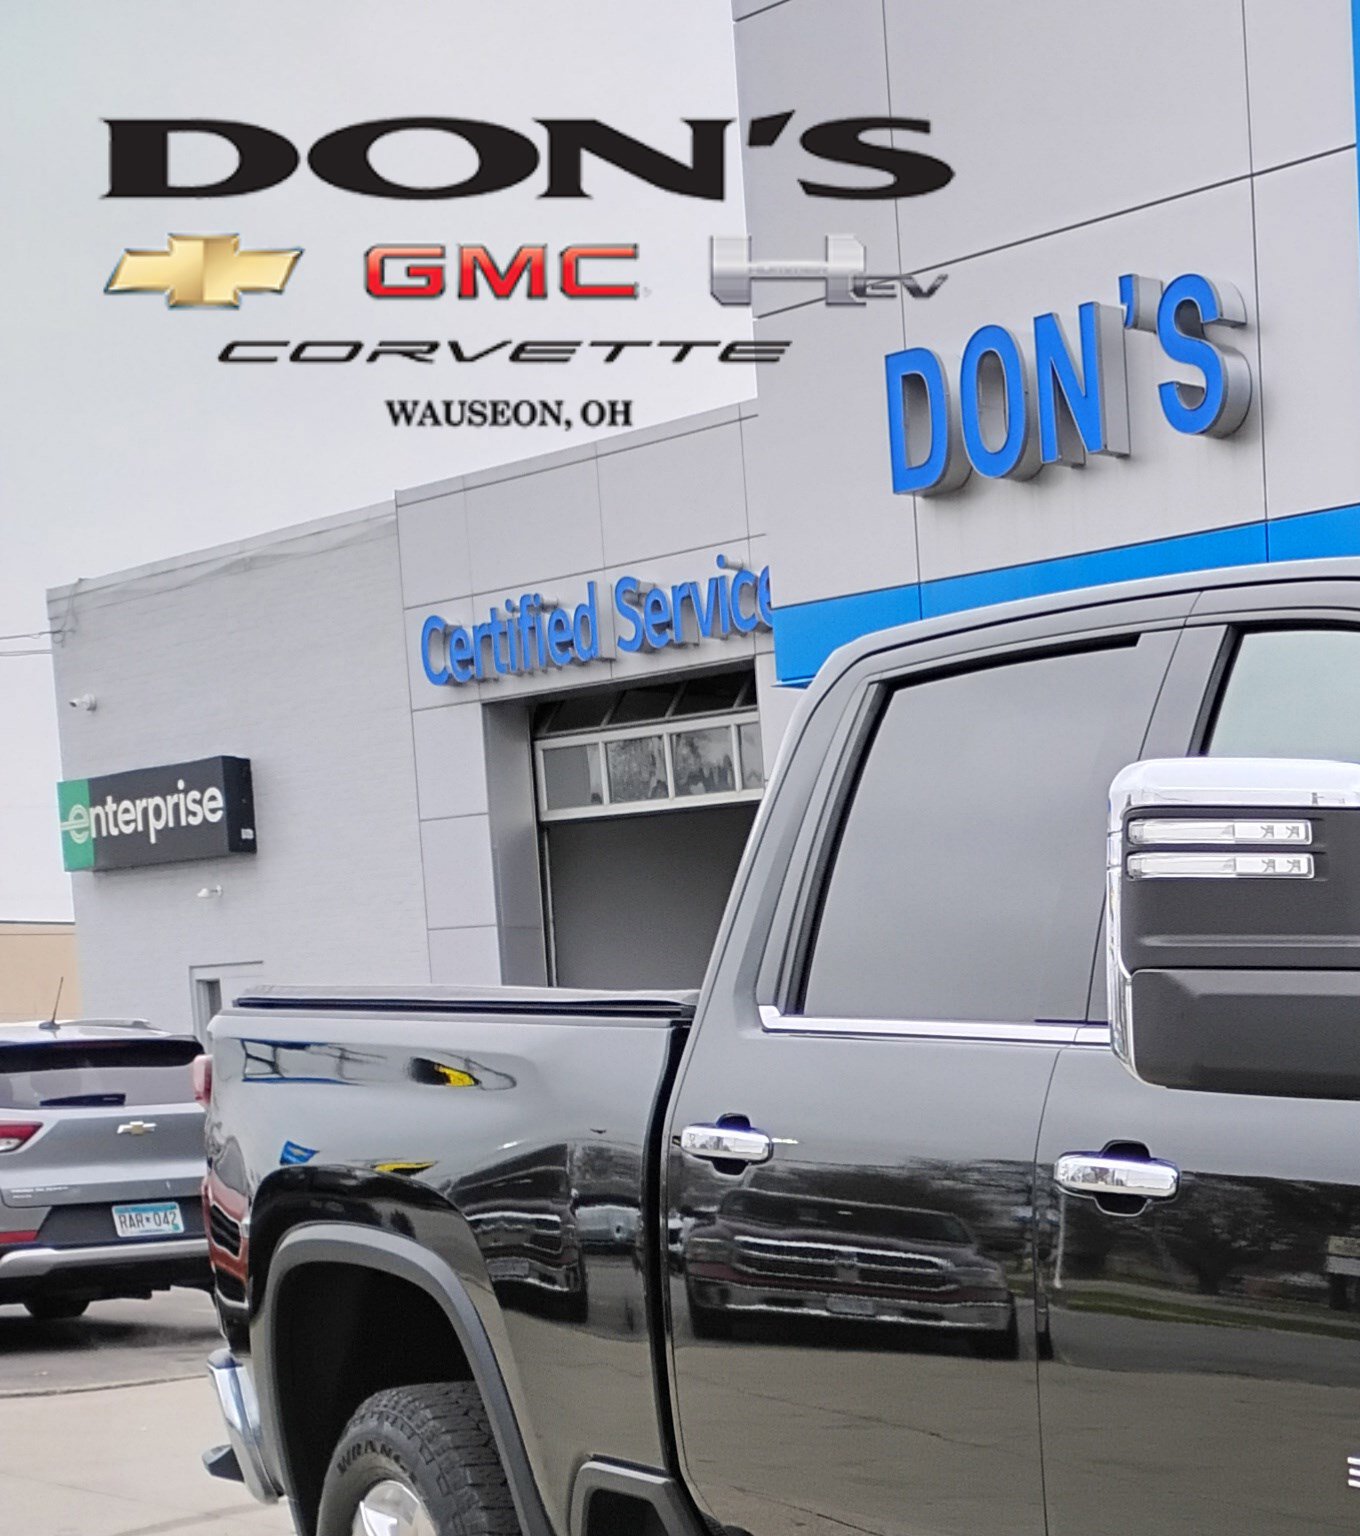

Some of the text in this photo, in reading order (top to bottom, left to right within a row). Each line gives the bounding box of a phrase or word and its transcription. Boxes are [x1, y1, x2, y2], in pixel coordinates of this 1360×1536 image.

[884, 273, 1250, 495] DON'S
[421, 580, 600, 687] Certified
[62, 778, 225, 845] enterprise
